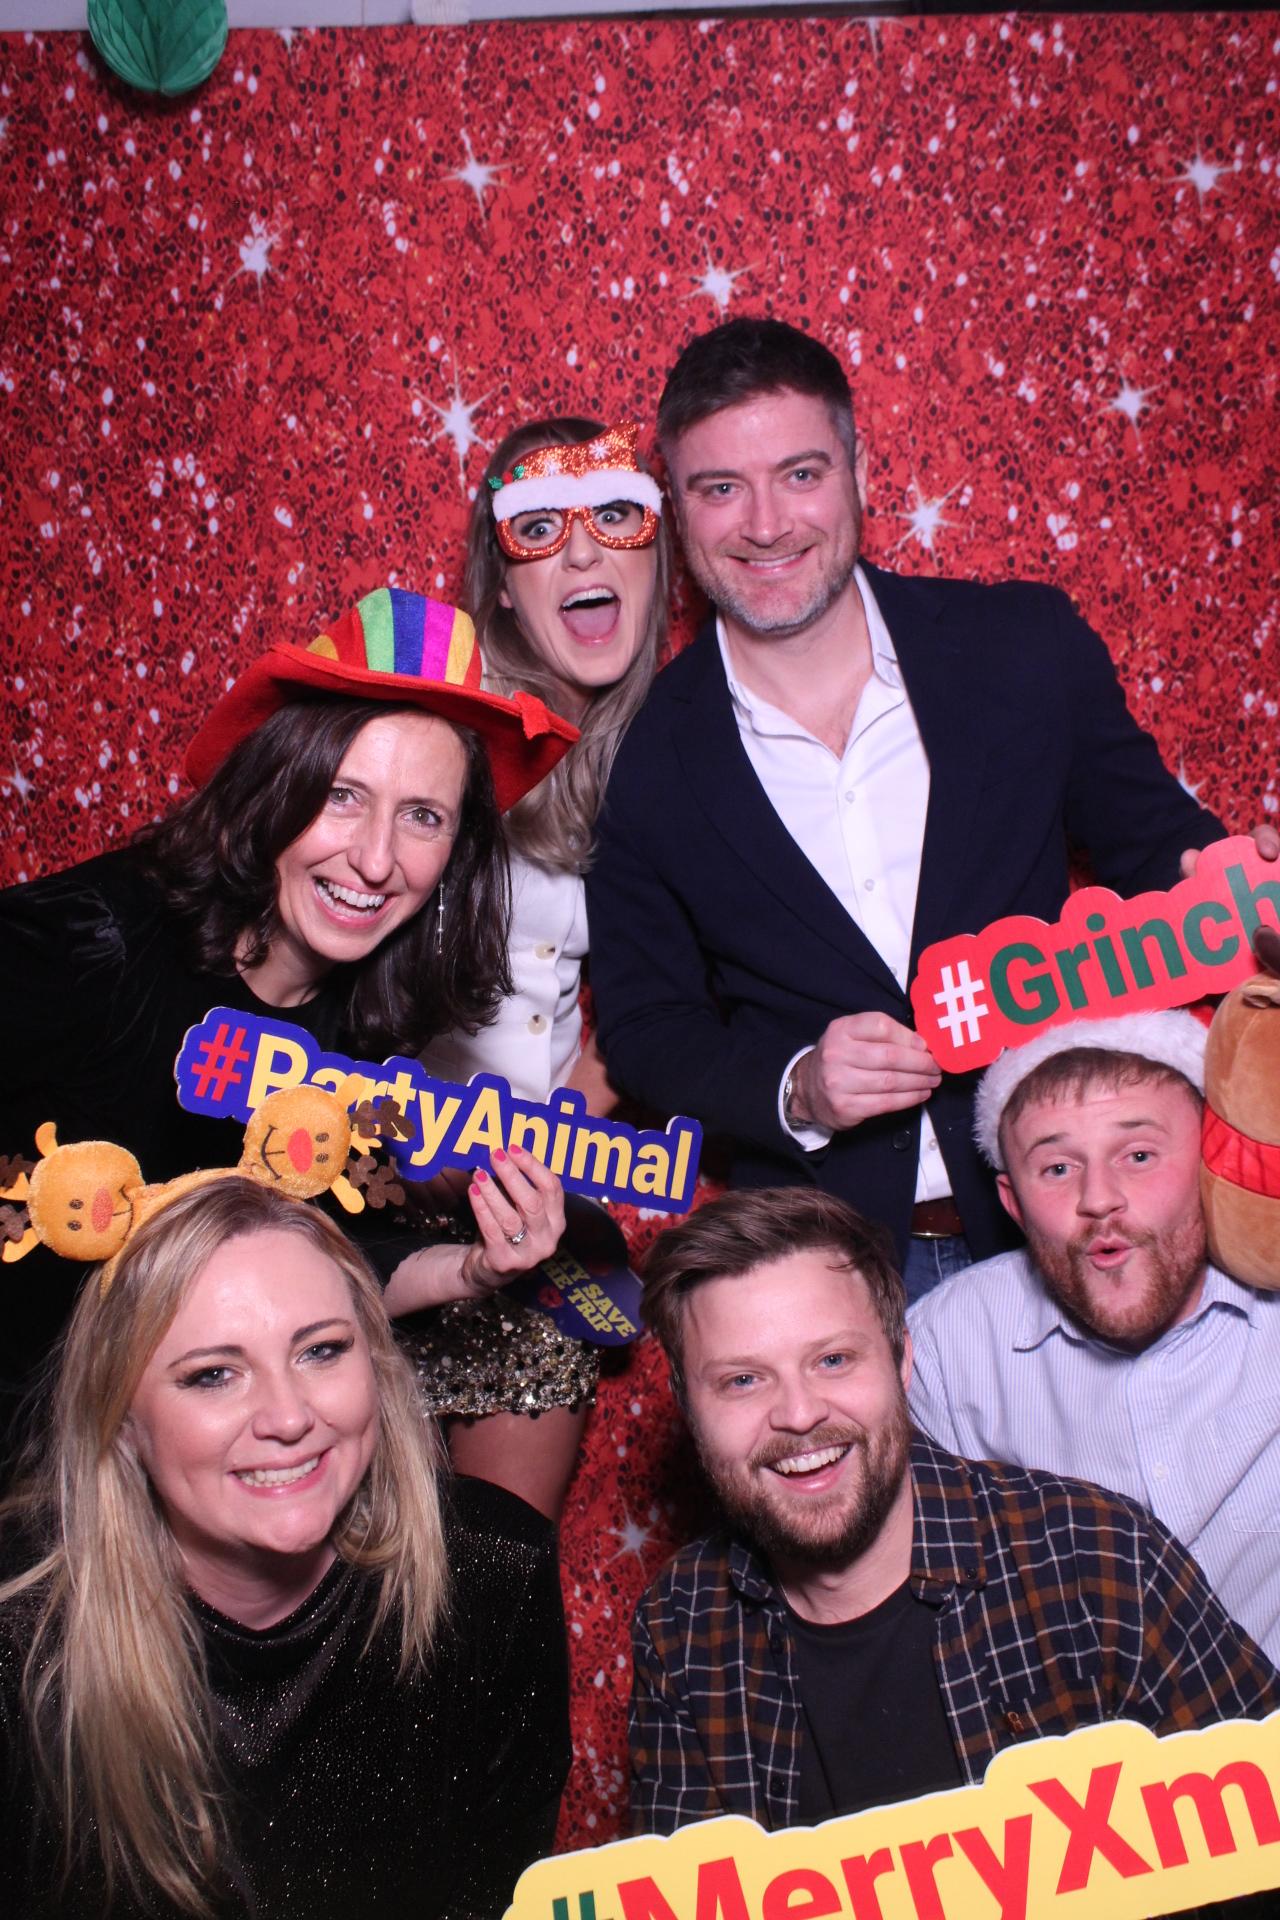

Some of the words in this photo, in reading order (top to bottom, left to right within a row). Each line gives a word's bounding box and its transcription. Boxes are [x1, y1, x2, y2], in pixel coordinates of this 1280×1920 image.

[934, 864, 1280, 1048] #Grinch
[567, 1287, 613, 1333] TRIP
[582, 1284, 637, 1337] SAVE
[553, 1761, 1280, 1920] MerryXm
